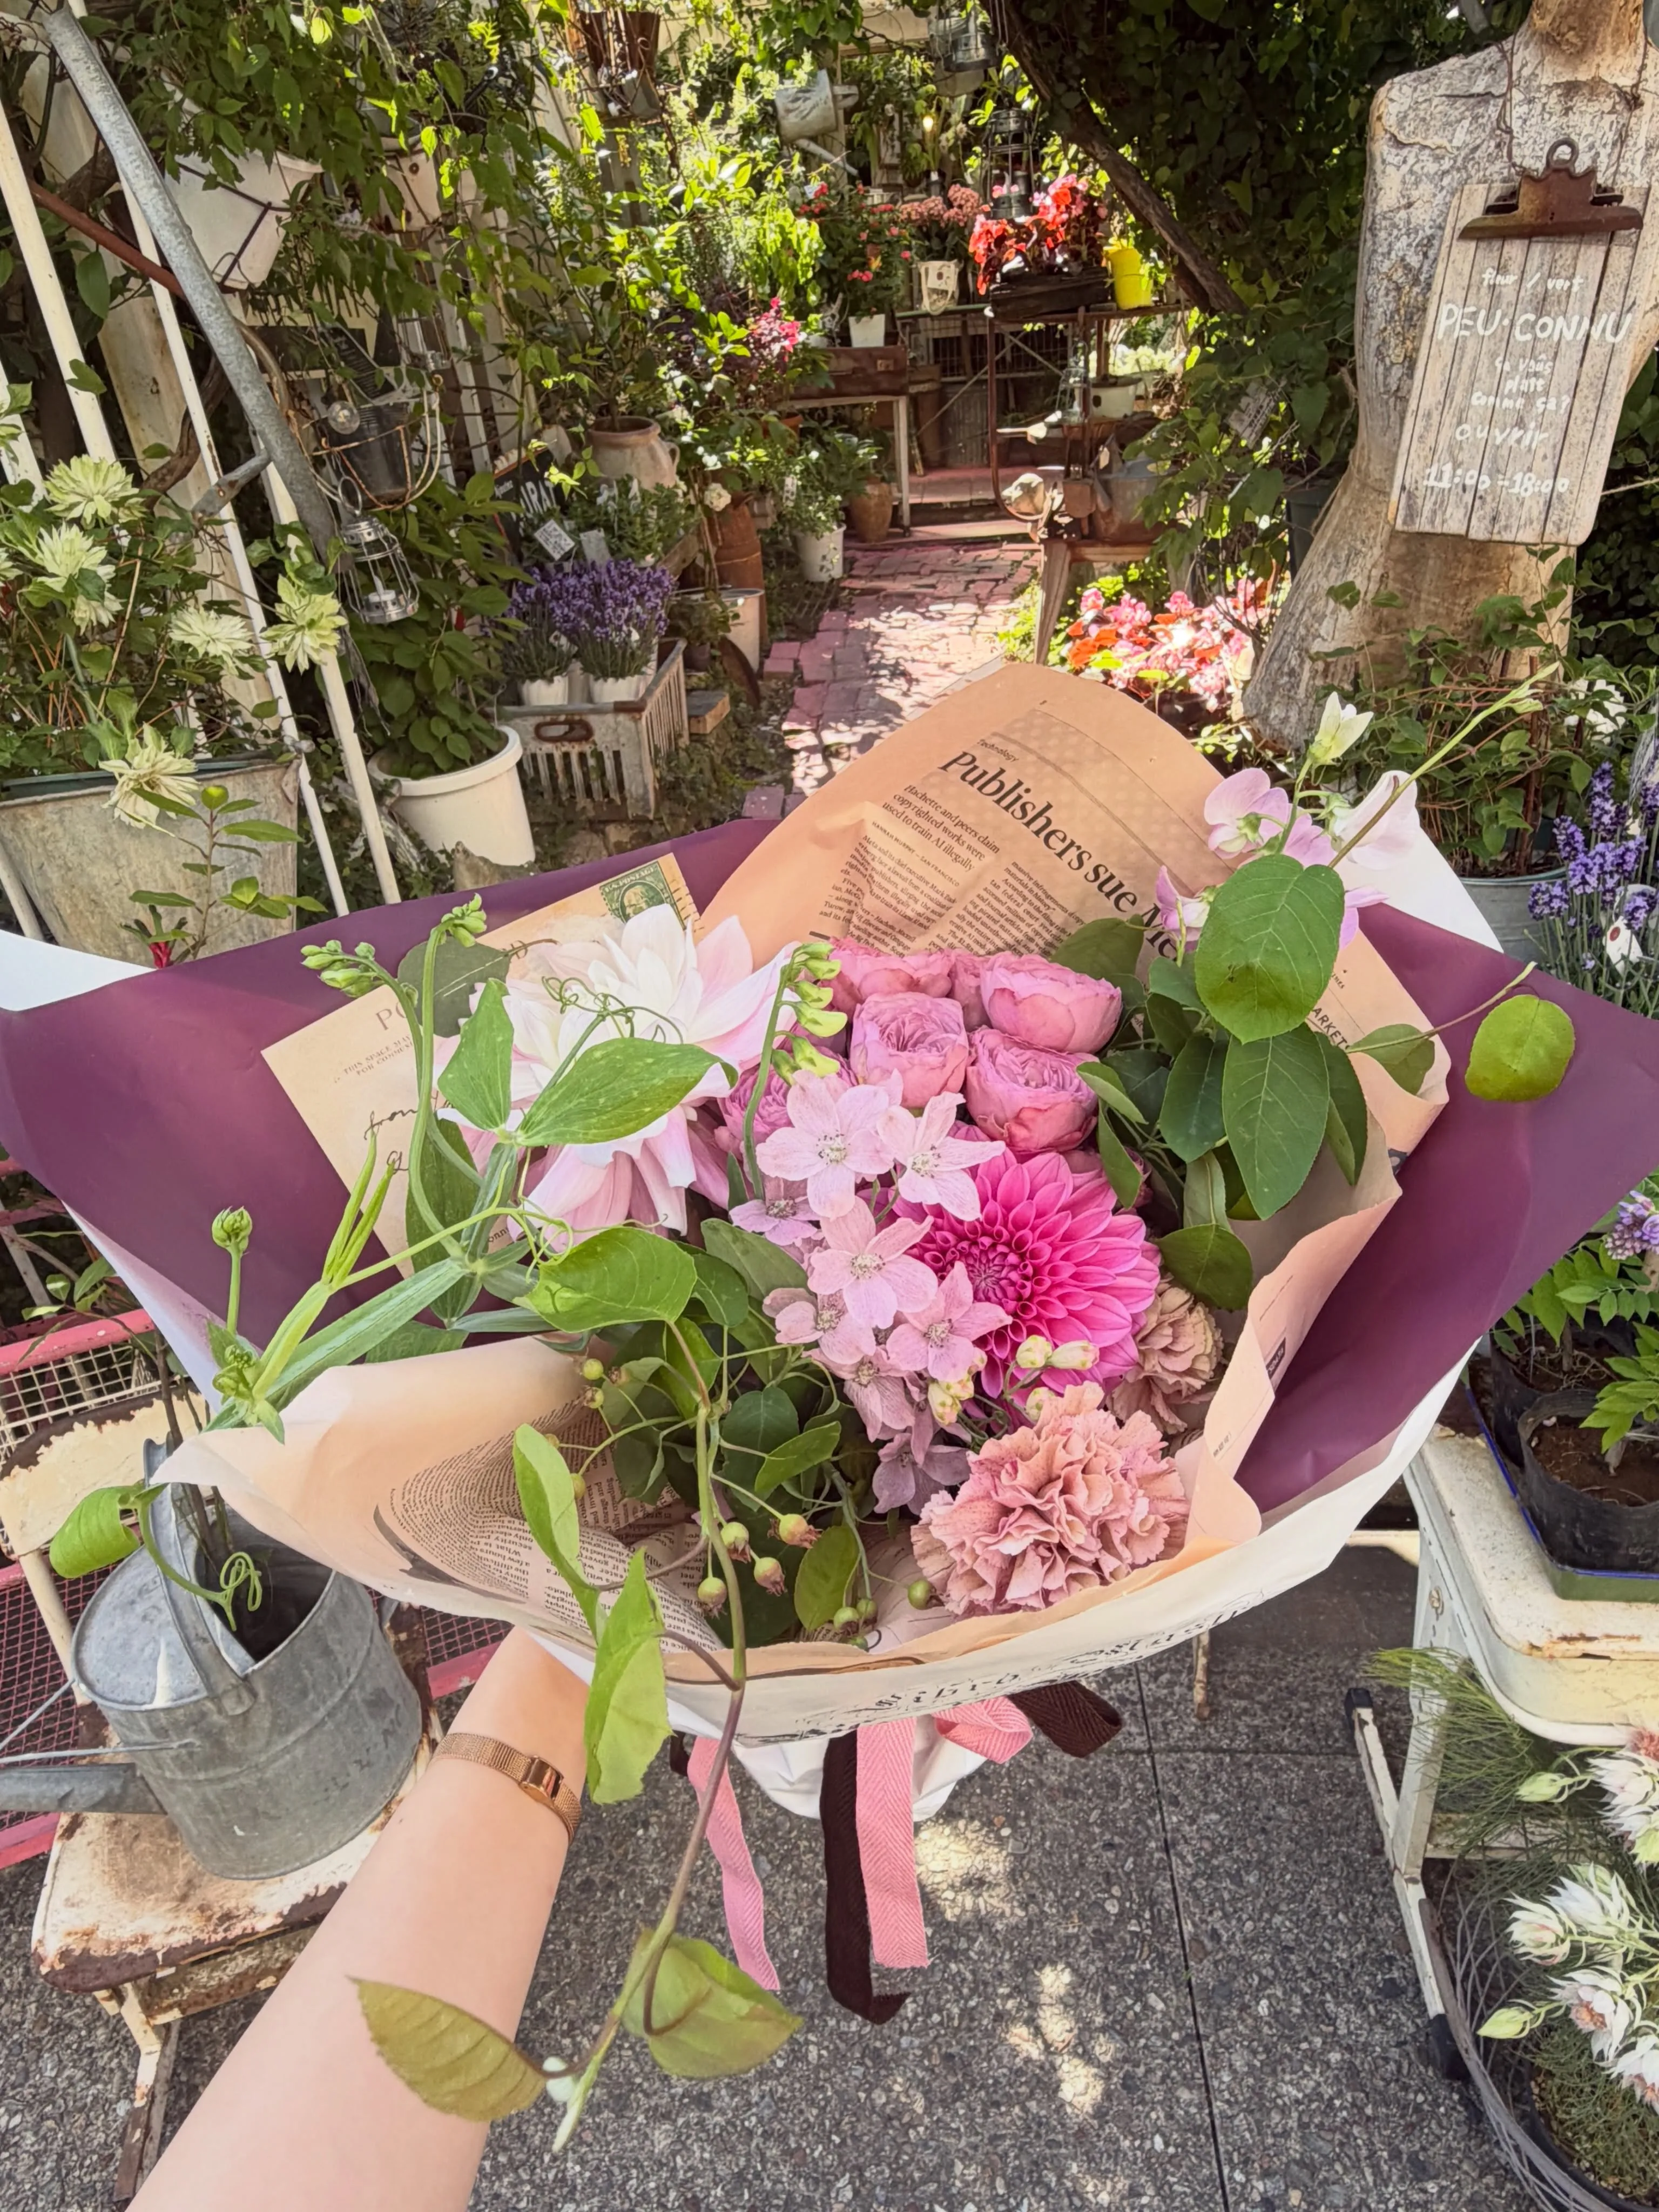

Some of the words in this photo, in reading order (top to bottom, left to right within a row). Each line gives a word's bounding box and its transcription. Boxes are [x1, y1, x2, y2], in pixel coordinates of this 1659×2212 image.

[1546, 275, 1584, 293] vert
[1455, 421, 1549, 450] ouvrir
[893, 794, 945, 829] copyrighted
[942, 826, 966, 847] works
[966, 842, 986, 861] were
[904, 785, 942, 811] Hachette
[940, 810, 960, 823] and
[954, 818, 979, 838] peers
[977, 835, 1000, 854] claim
[882, 802, 906, 819] used
[902, 815, 912, 826] to
[912, 821, 933, 840] train
[943, 844, 975, 872] illegally
[938, 751, 1092, 871] Publishers
[1084, 864, 1137, 912] sue
[862, 835, 878, 848] Meta
[878, 846, 888, 857] and
[906, 867, 930, 886] executive
[929, 884, 945, 898] Mark
[894, 838, 916, 854] MURPHY
[920, 856, 931, 866] SAN
[931, 864, 960, 887] FRANCISCO
[1011, 861, 1034, 881] massive
[842, 878, 857, 888] Five
[907, 879, 920, 891] from
[1002, 878, 1028, 902] According
[1033, 904, 1043, 914] the
[1002, 889, 1023, 908] federal
[1023, 908, 1039, 922] court
[920, 901, 931, 912] the
[969, 899, 980, 910] ing
[977, 908, 1000, 925] pirated
[976, 893, 989, 903] and
[986, 901, 1007, 918] journal
[1004, 917, 1024, 933] articles
[948, 929, 959, 940] The
[966, 920, 975, 929] the
[936, 933, 949, 943] and
[1312, 1007, 1350, 1049] ARKET
[365, 1046, 392, 1062] SPACE
[356, 1064, 374, 1076] FOR
[493, 1535, 532, 1551] security
[495, 1543, 521, 1557] What
[507, 1555, 525, 1566] few
